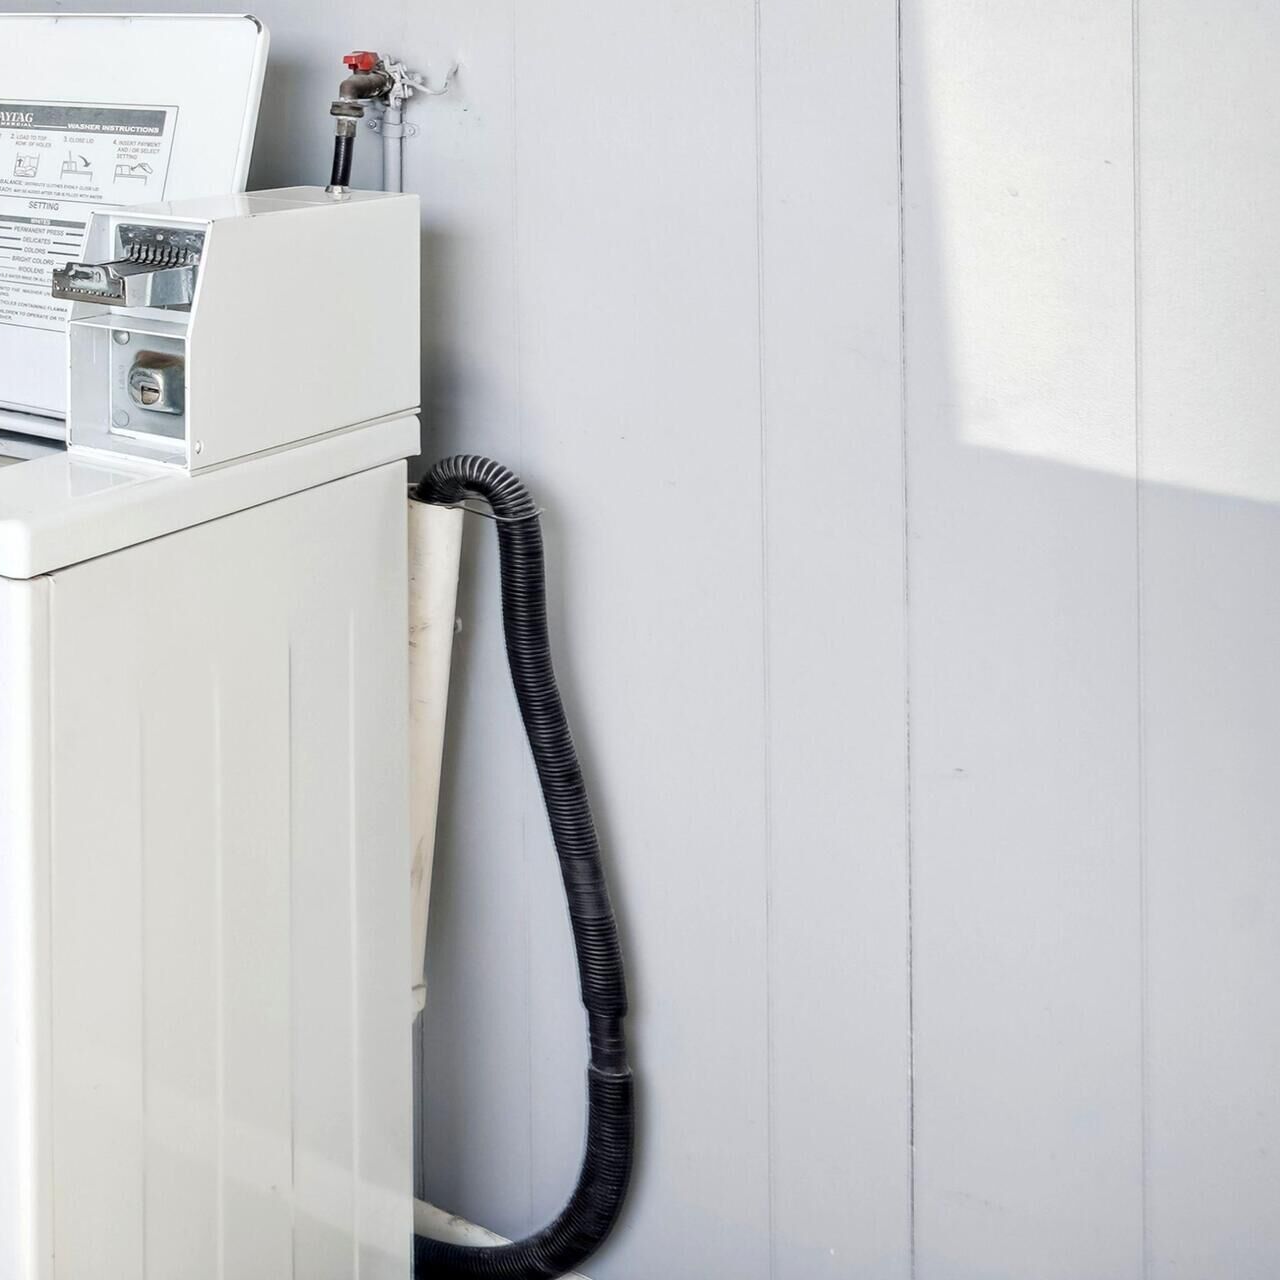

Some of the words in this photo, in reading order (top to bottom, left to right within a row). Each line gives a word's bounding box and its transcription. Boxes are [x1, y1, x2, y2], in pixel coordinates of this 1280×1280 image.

[68, 123, 100, 131] WASHER
[102, 125, 159, 133] INSTRUCTIONS
[29, 201, 59, 210] SETTING
[14, 226, 45, 234] PERMANENT
